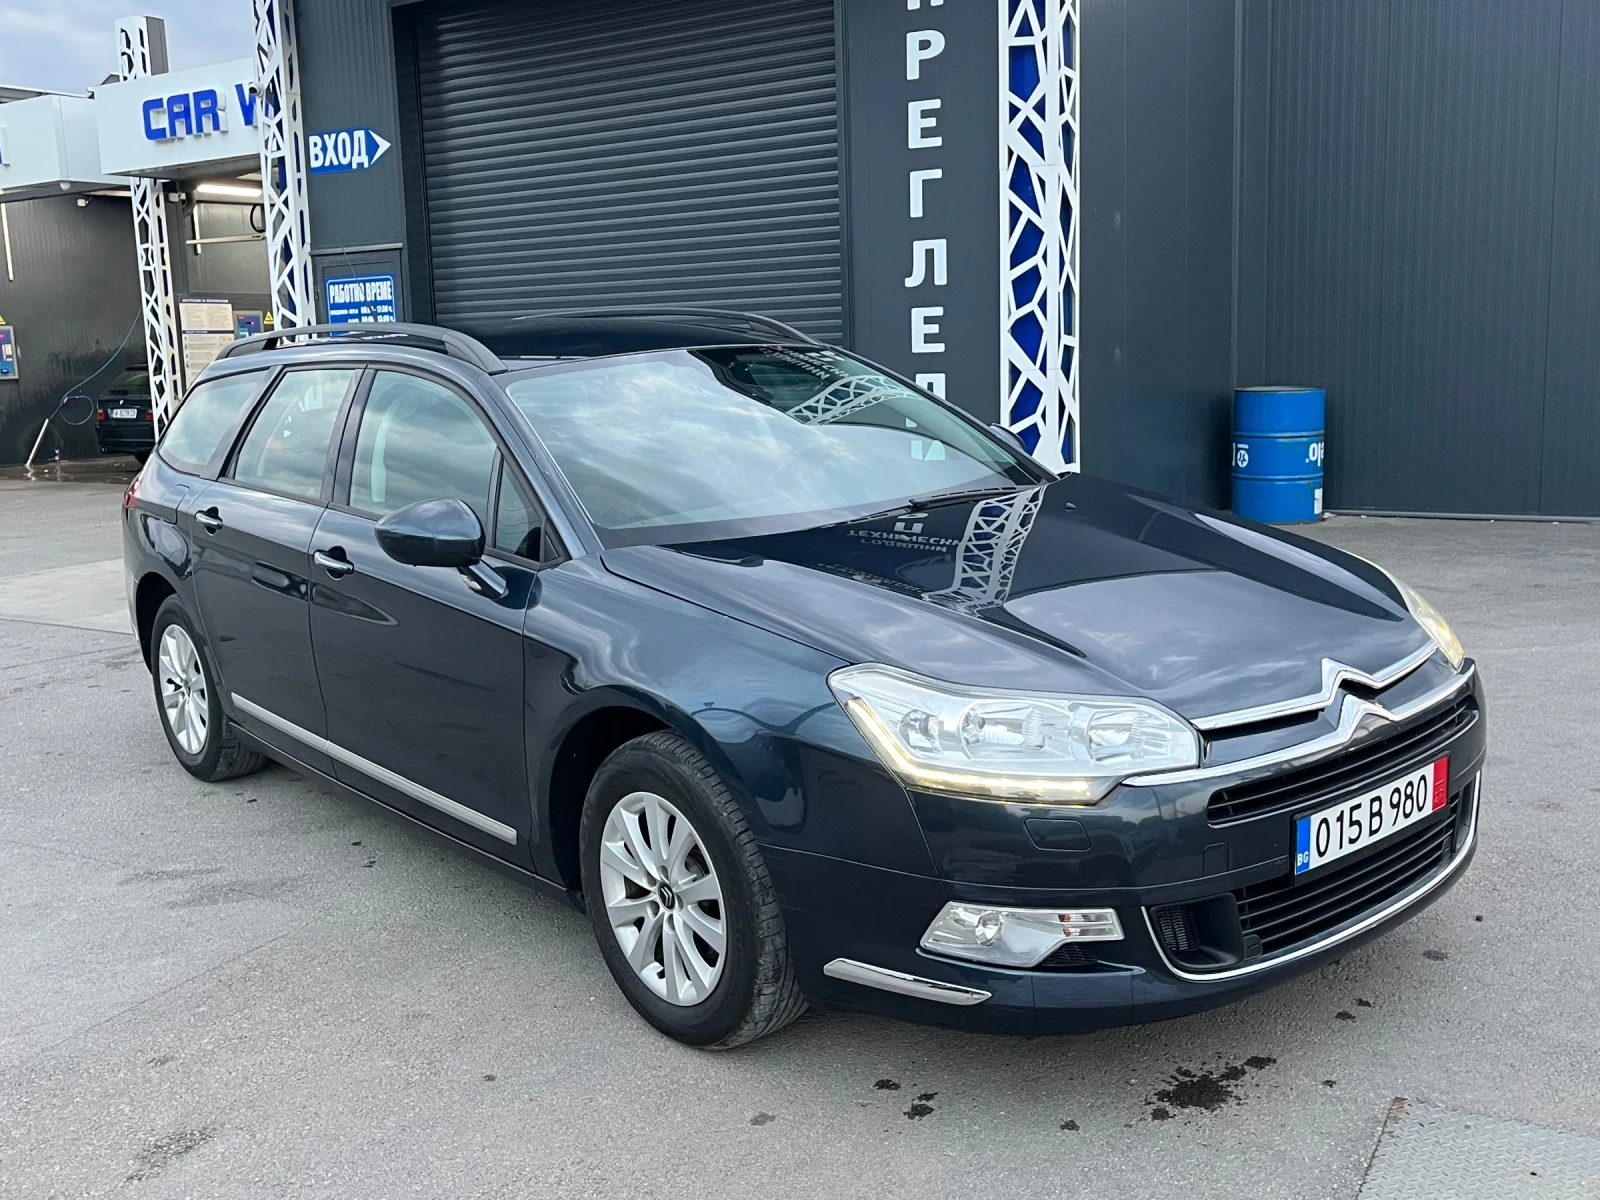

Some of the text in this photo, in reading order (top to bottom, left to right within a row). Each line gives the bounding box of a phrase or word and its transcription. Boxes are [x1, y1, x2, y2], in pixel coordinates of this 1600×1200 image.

[143, 88, 224, 141] CAR
[308, 129, 369, 169] ВХОД
[329, 280, 392, 304] РАБОТНО ВРЕМЕ
[1297, 851, 1309, 867] BG
